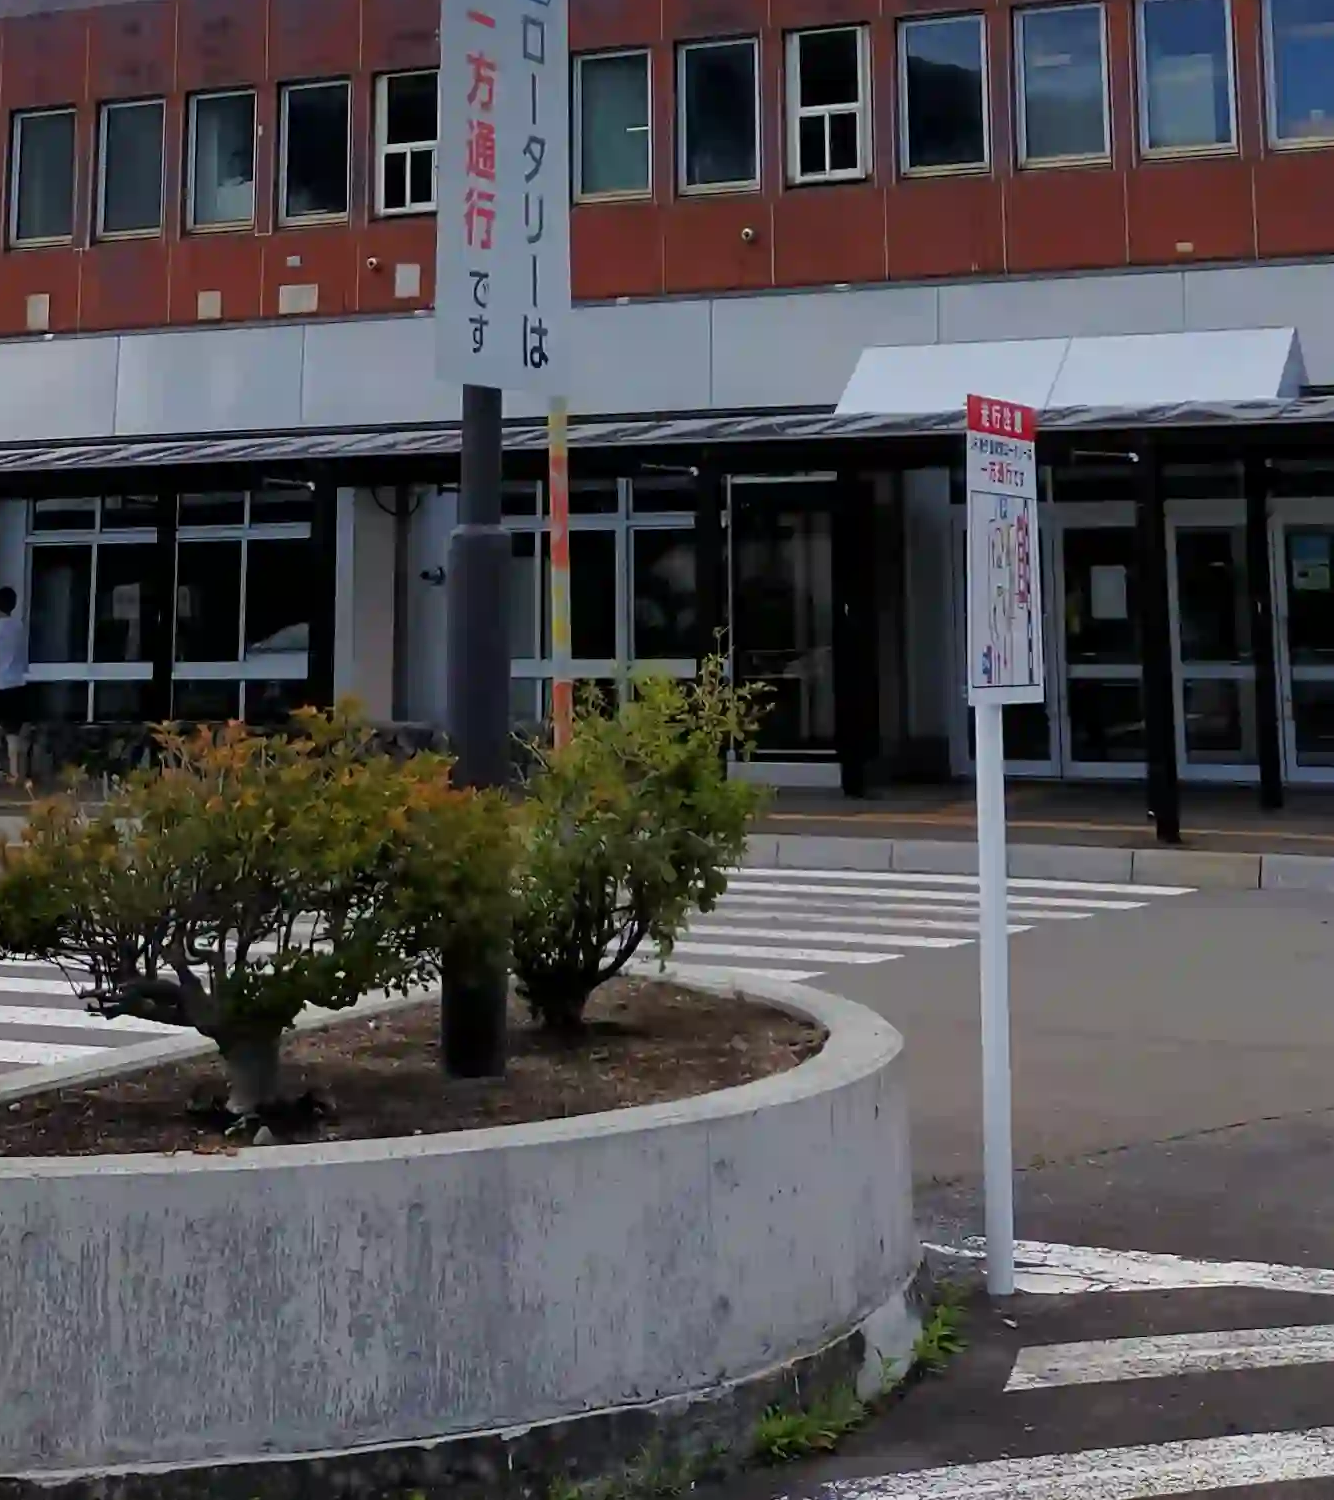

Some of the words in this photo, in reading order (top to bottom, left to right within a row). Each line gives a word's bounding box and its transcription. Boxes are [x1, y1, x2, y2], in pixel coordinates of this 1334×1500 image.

[463, 9, 497, 355] 一方通行です
[521, 13, 550, 370] ロータリーは
